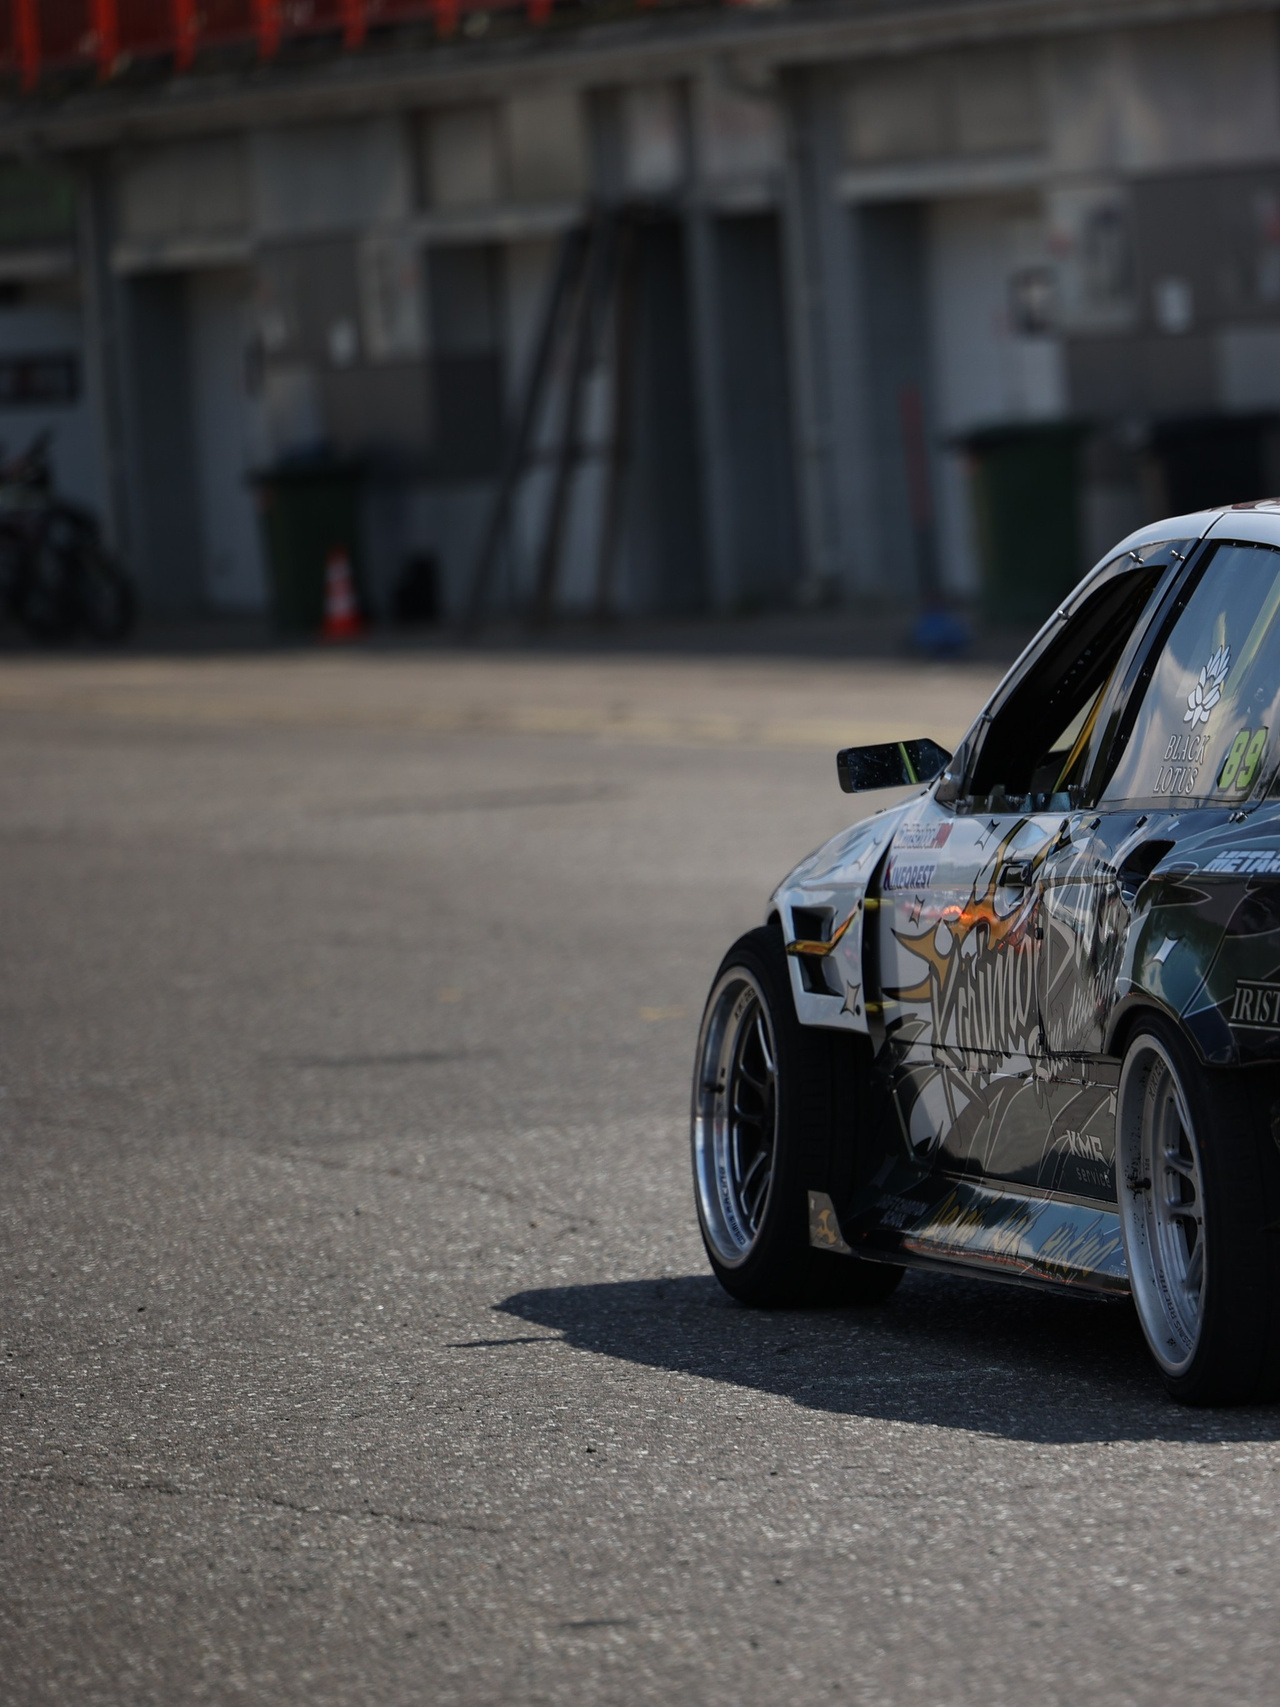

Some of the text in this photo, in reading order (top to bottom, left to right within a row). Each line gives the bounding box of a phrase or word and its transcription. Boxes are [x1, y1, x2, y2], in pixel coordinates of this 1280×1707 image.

[1164, 734, 1211, 765] BLACK
[1218, 728, 1268, 789] 89
[1153, 766, 1199, 794] LOTUS
[884, 856, 936, 891] KINFOREST
[1076, 1167, 1112, 1189] service
